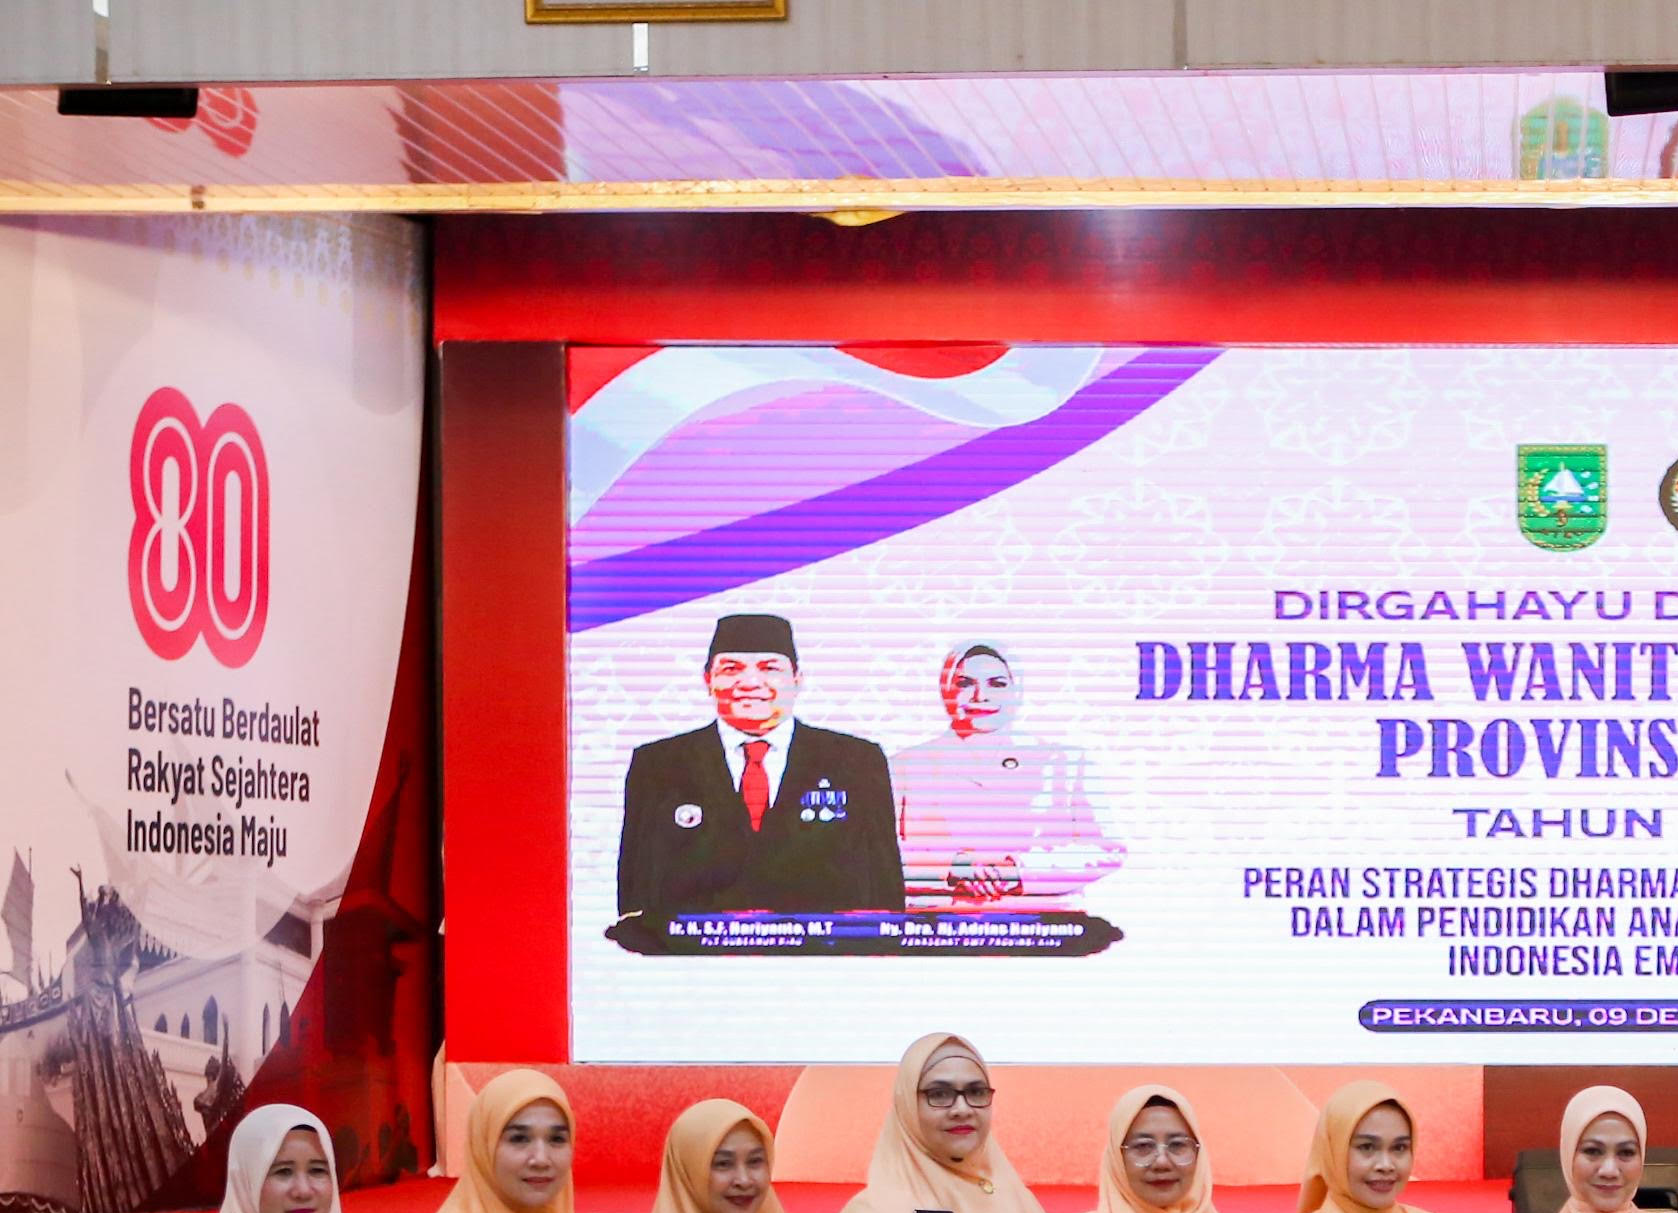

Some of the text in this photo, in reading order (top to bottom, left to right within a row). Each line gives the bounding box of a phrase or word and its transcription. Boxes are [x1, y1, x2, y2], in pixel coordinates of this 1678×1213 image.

[128, 386, 270, 669] 80
[1274, 590, 1632, 621] DIRGAHAYU
[1135, 641, 1434, 701] DHARMA
[128, 687, 320, 746] Bersatu Berdaulat
[127, 748, 310, 809] Rakyat Sejahtera
[127, 809, 288, 868] Indonesia Maju
[1452, 808, 1662, 838] TAHUN
[1244, 867, 1350, 899] PERAN
[1362, 867, 1537, 899] STRATEGIS
[1291, 906, 1405, 938] DALAM
[1417, 906, 1615, 938] PENDIDIKAN
[1449, 945, 1623, 976] INDONESIA
[1372, 1007, 1582, 1027] PEKANBARU,
[1589, 1007, 1627, 1026] 09
